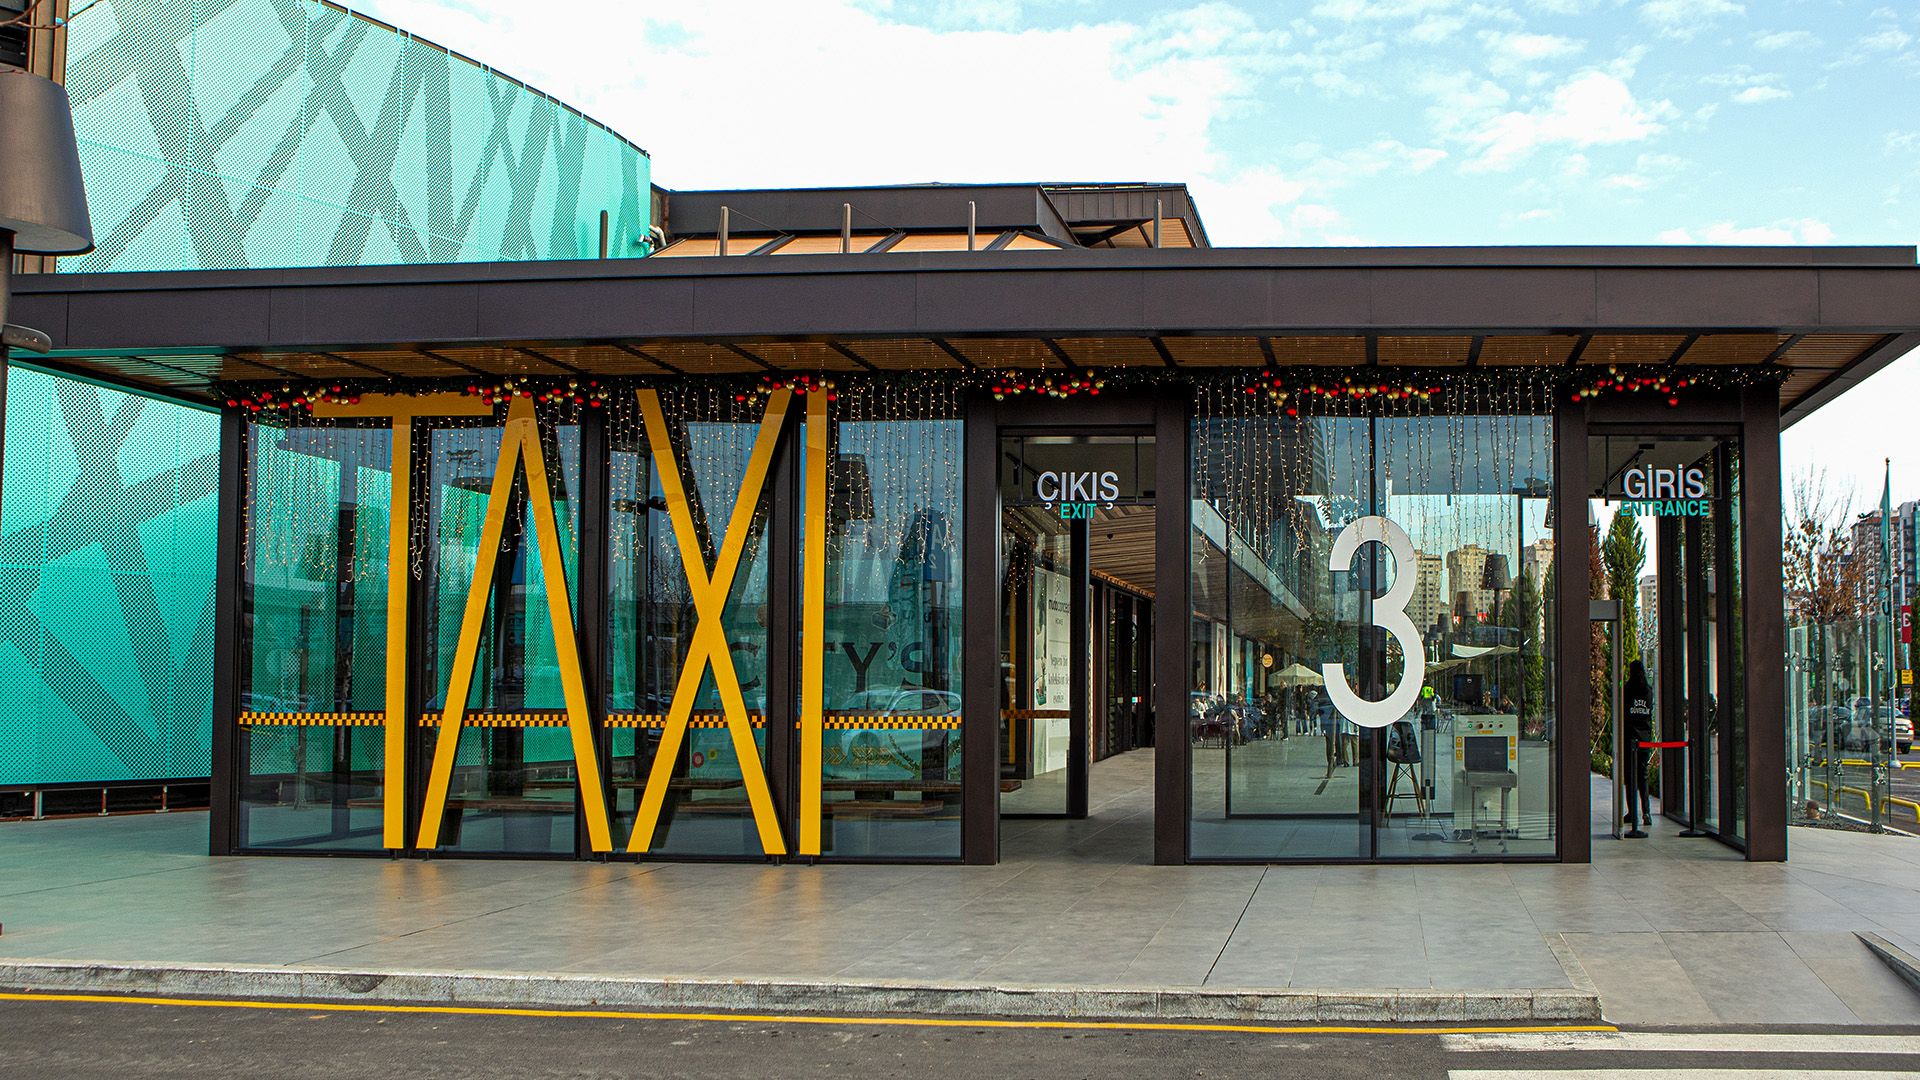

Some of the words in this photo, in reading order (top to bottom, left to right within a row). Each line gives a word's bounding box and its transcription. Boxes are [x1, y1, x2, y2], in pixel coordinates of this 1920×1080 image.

[1037, 471, 1119, 510] ÇIKIŞ
[1621, 500, 1710, 516] ENTRANCE
[1061, 503, 1097, 519] EXIT
[313, 388, 827, 855] TAXI
[1323, 516, 1426, 729] 3
